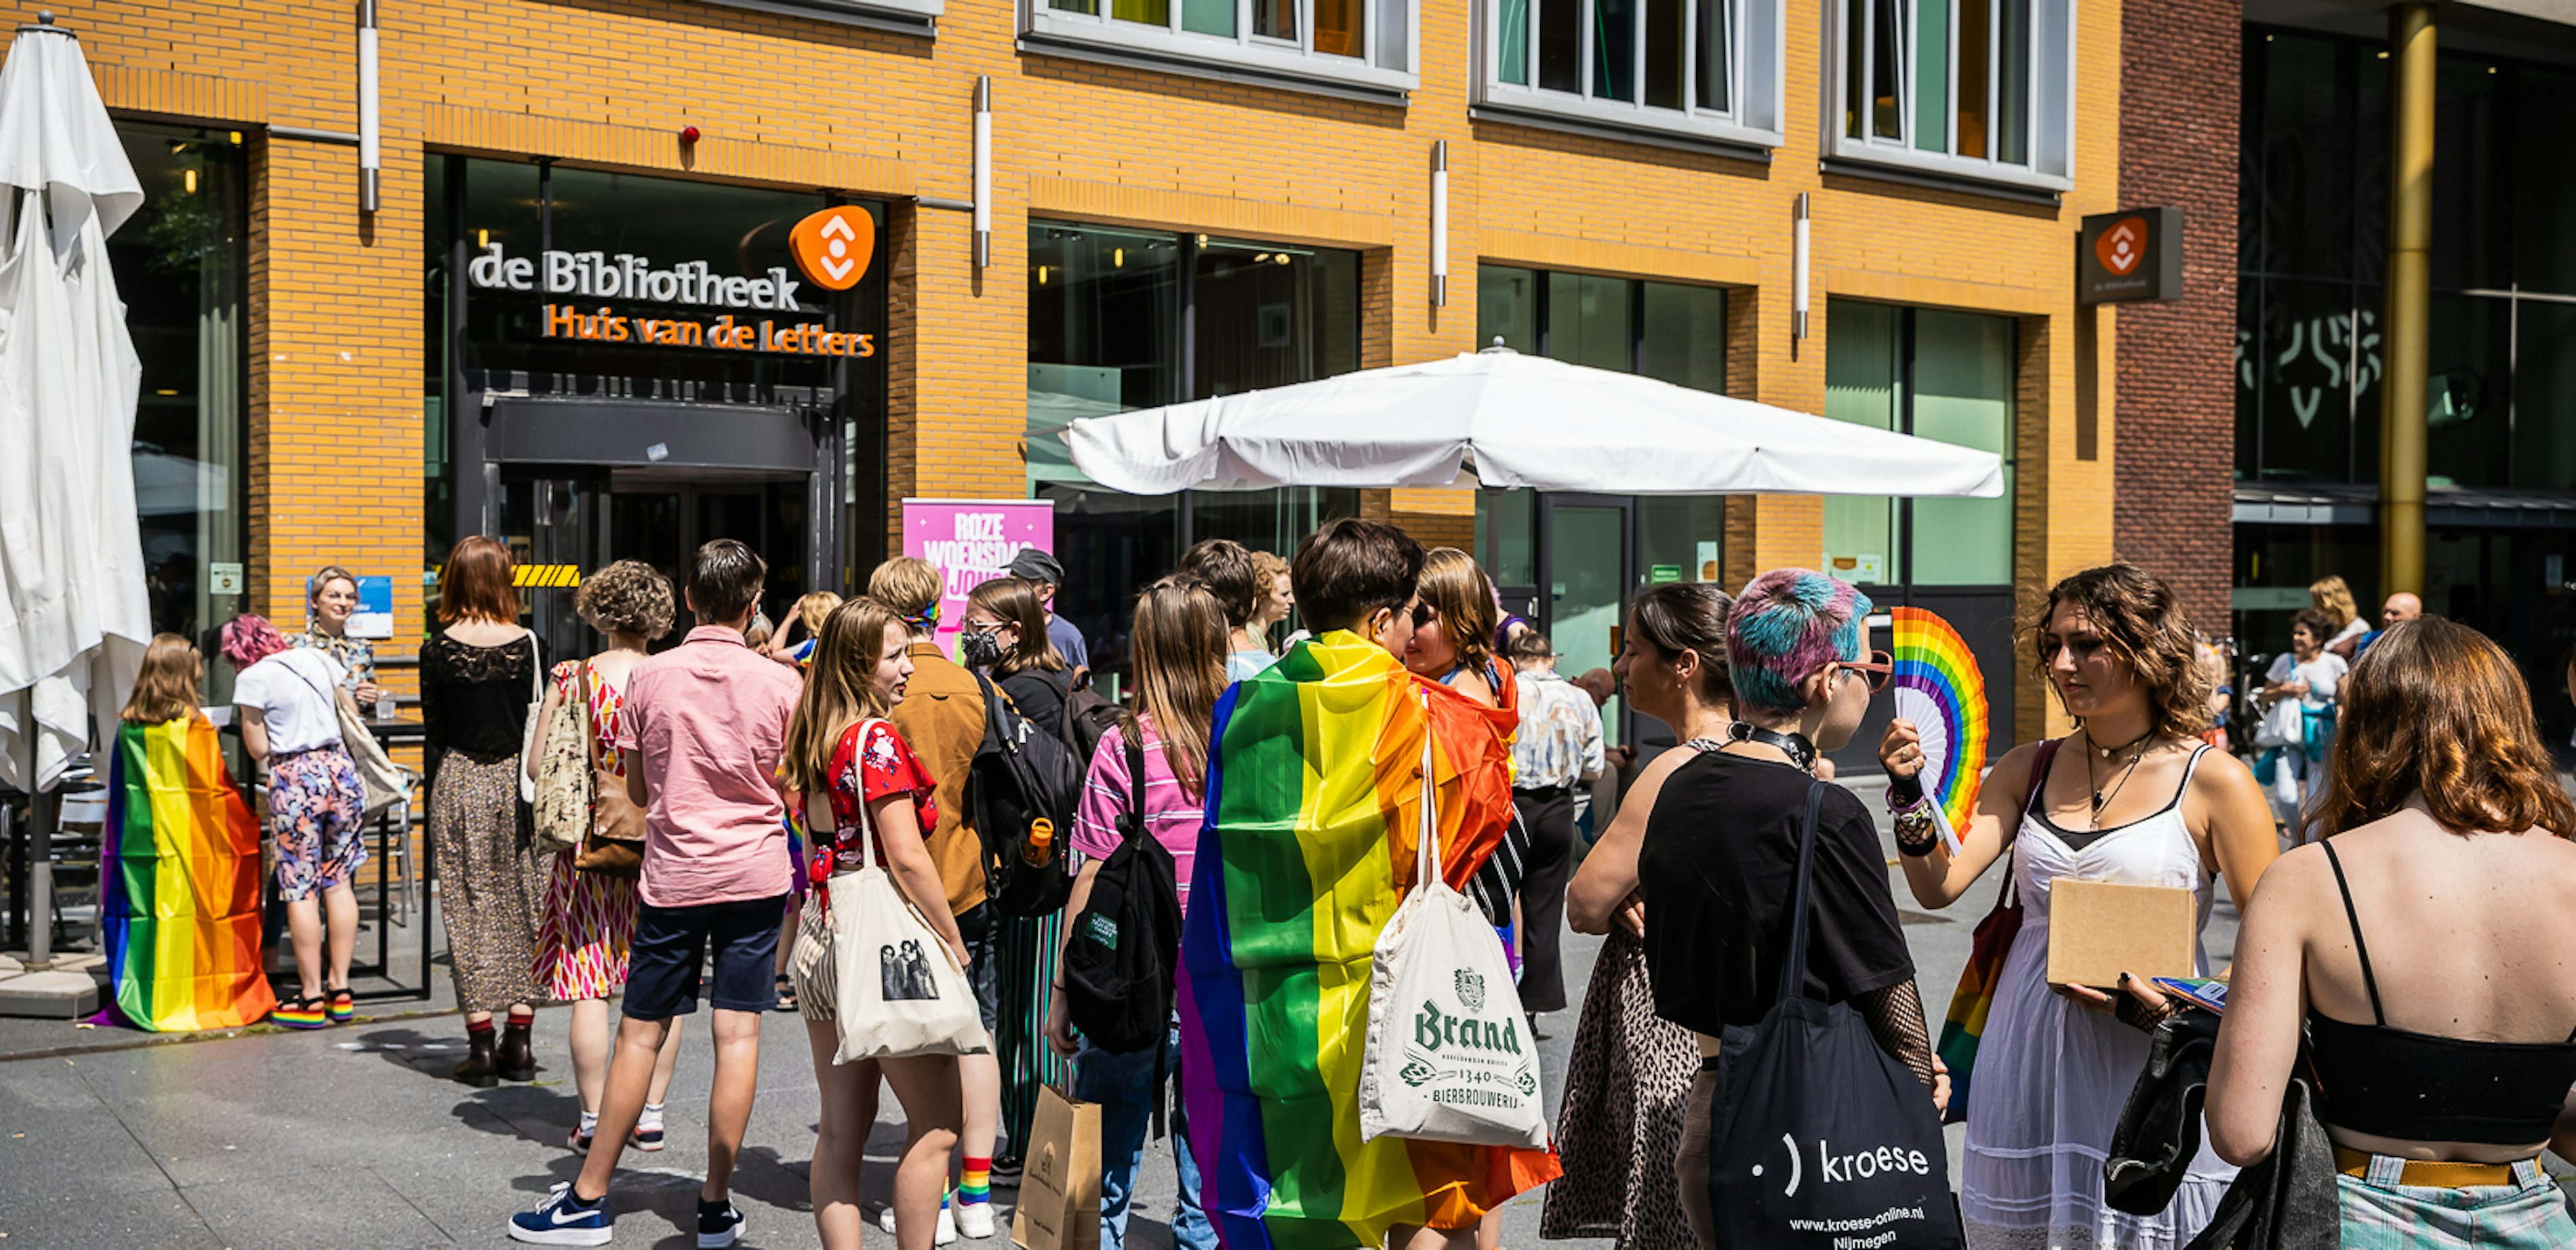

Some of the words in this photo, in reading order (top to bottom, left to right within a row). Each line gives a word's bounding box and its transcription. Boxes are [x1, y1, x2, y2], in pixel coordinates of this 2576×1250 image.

[468, 242, 534, 290] de
[542, 250, 800, 311] Bibliotheek
[542, 304, 629, 342] Huis
[633, 317, 702, 346] van
[708, 315, 754, 350] de
[759, 320, 874, 357] Letters
[954, 512, 1005, 540] ROZE
[924, 540, 1034, 569] WOENSDA
[1415, 999, 1523, 1055] Brand
[1460, 1069, 1491, 1084] 1340
[1433, 1089, 1518, 1109] BIERBROUWERIJ
[1820, 1139, 1929, 1183] kroese
[1789, 1206, 1925, 1232] www.kroese-online.nl
[1833, 1230, 1896, 1250] Nijmegen
